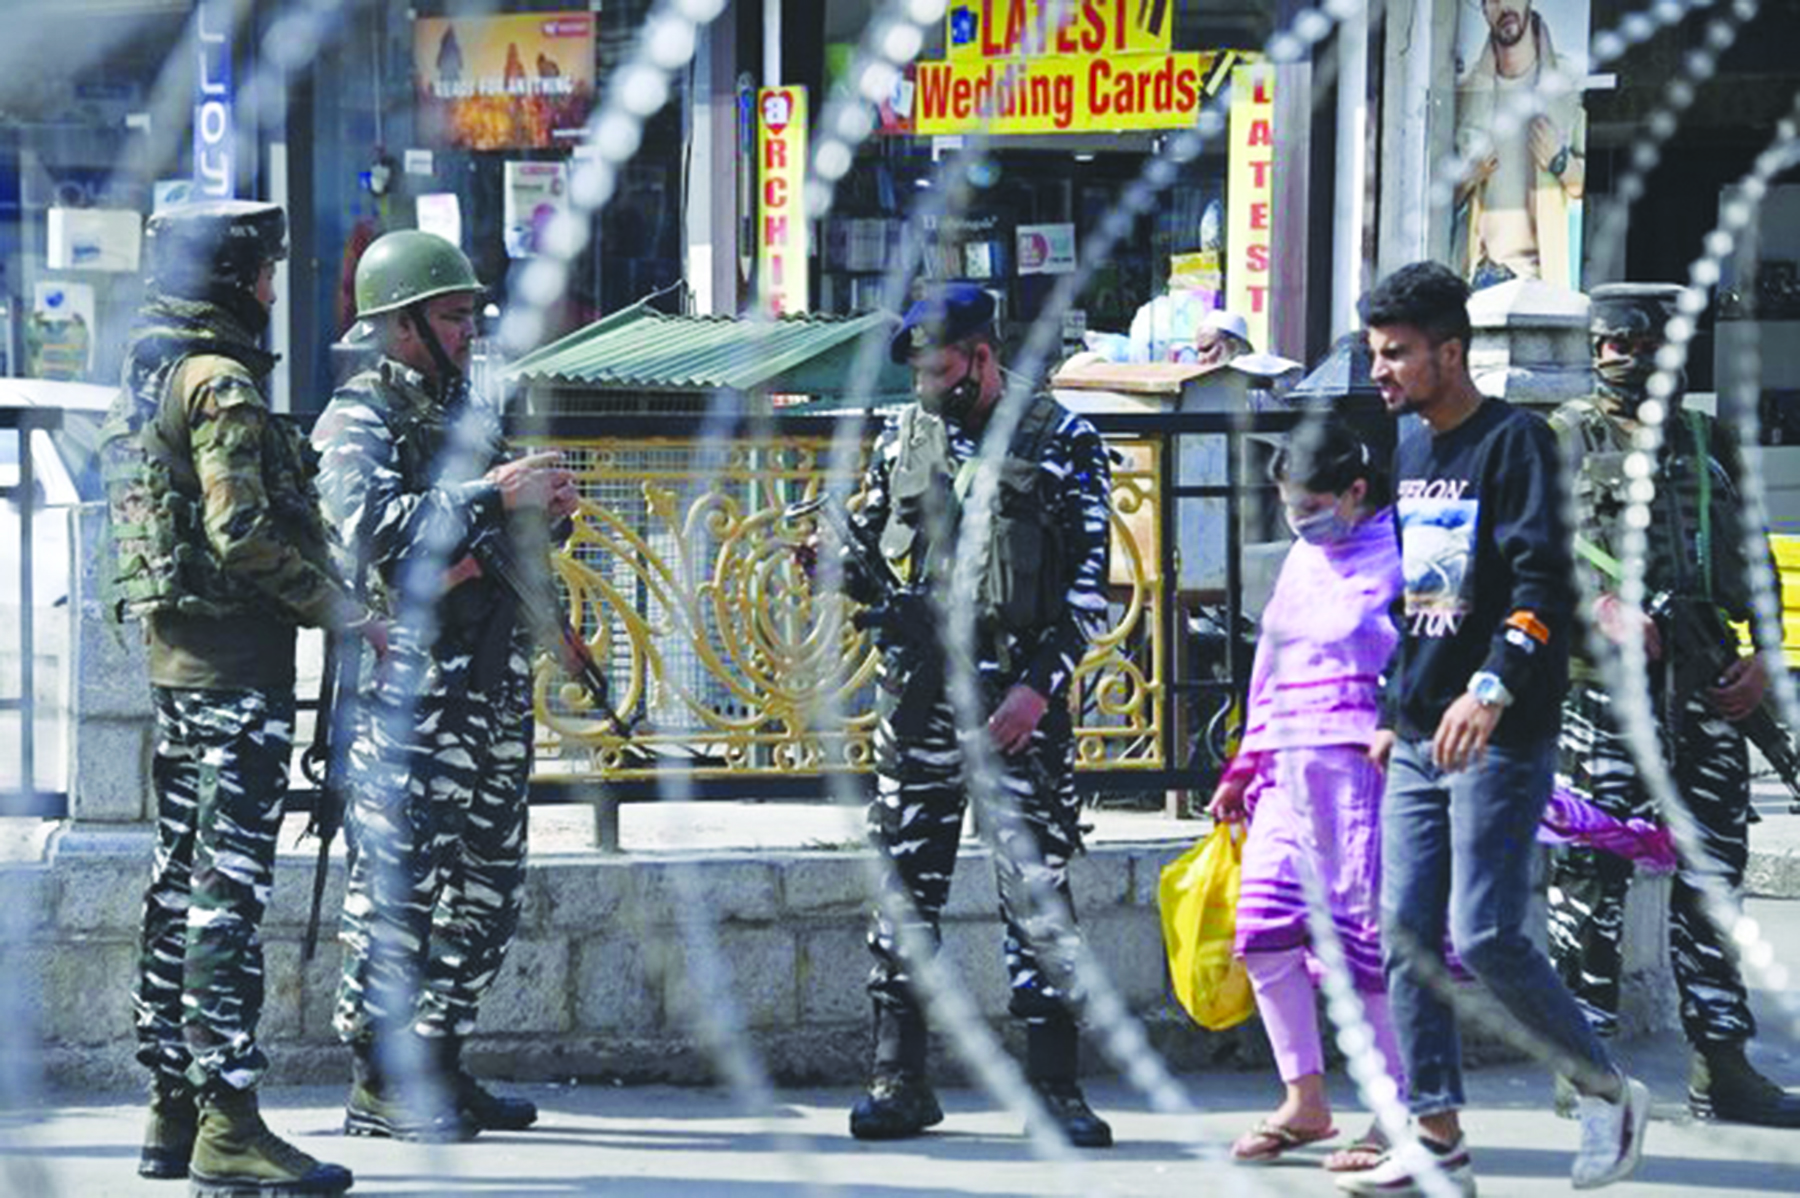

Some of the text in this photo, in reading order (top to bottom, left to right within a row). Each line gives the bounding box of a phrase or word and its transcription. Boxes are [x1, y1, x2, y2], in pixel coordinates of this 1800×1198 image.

[981, 0, 1127, 56] LATEST
[919, 54, 1197, 129] Wedding Cards
[1247, 77, 1272, 313] LATEST
